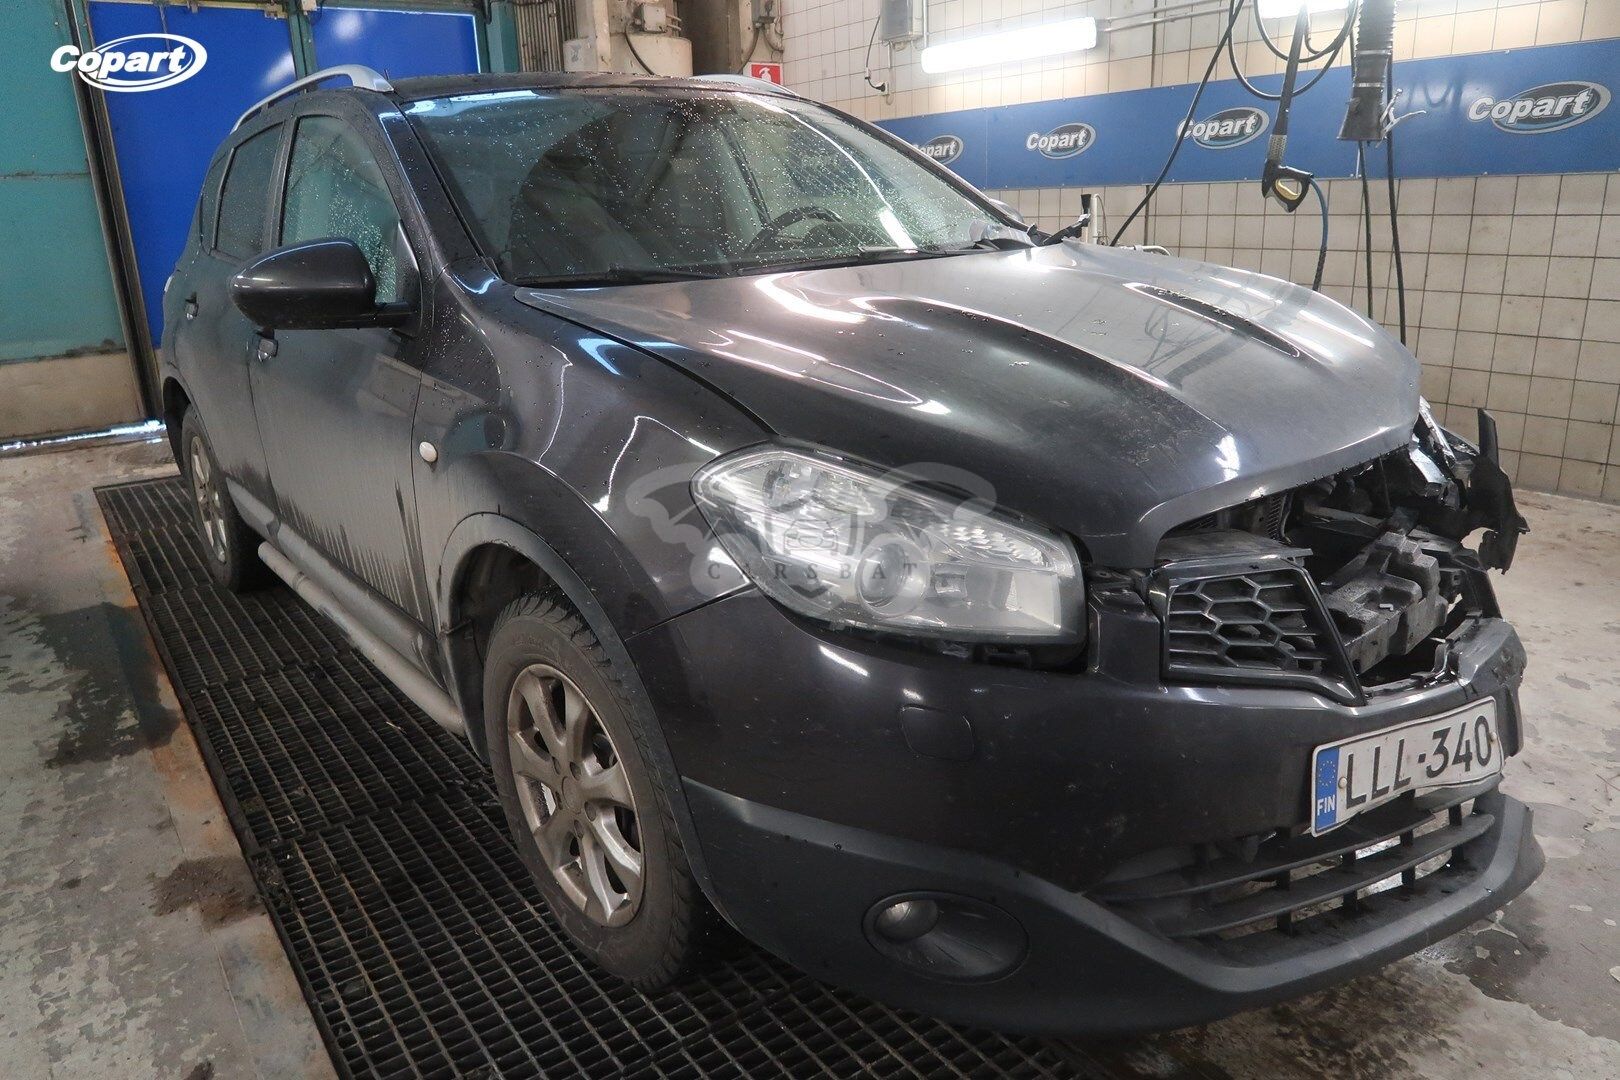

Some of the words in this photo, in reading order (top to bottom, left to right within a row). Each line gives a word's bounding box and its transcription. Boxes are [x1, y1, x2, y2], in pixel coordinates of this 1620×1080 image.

[1467, 88, 1593, 124] Copart
[1177, 114, 1258, 141] Copart
[913, 141, 956, 157] opart
[1026, 130, 1087, 152] Copart
[1346, 715, 1492, 810] LLL-340
[1317, 795, 1336, 815] FIN
